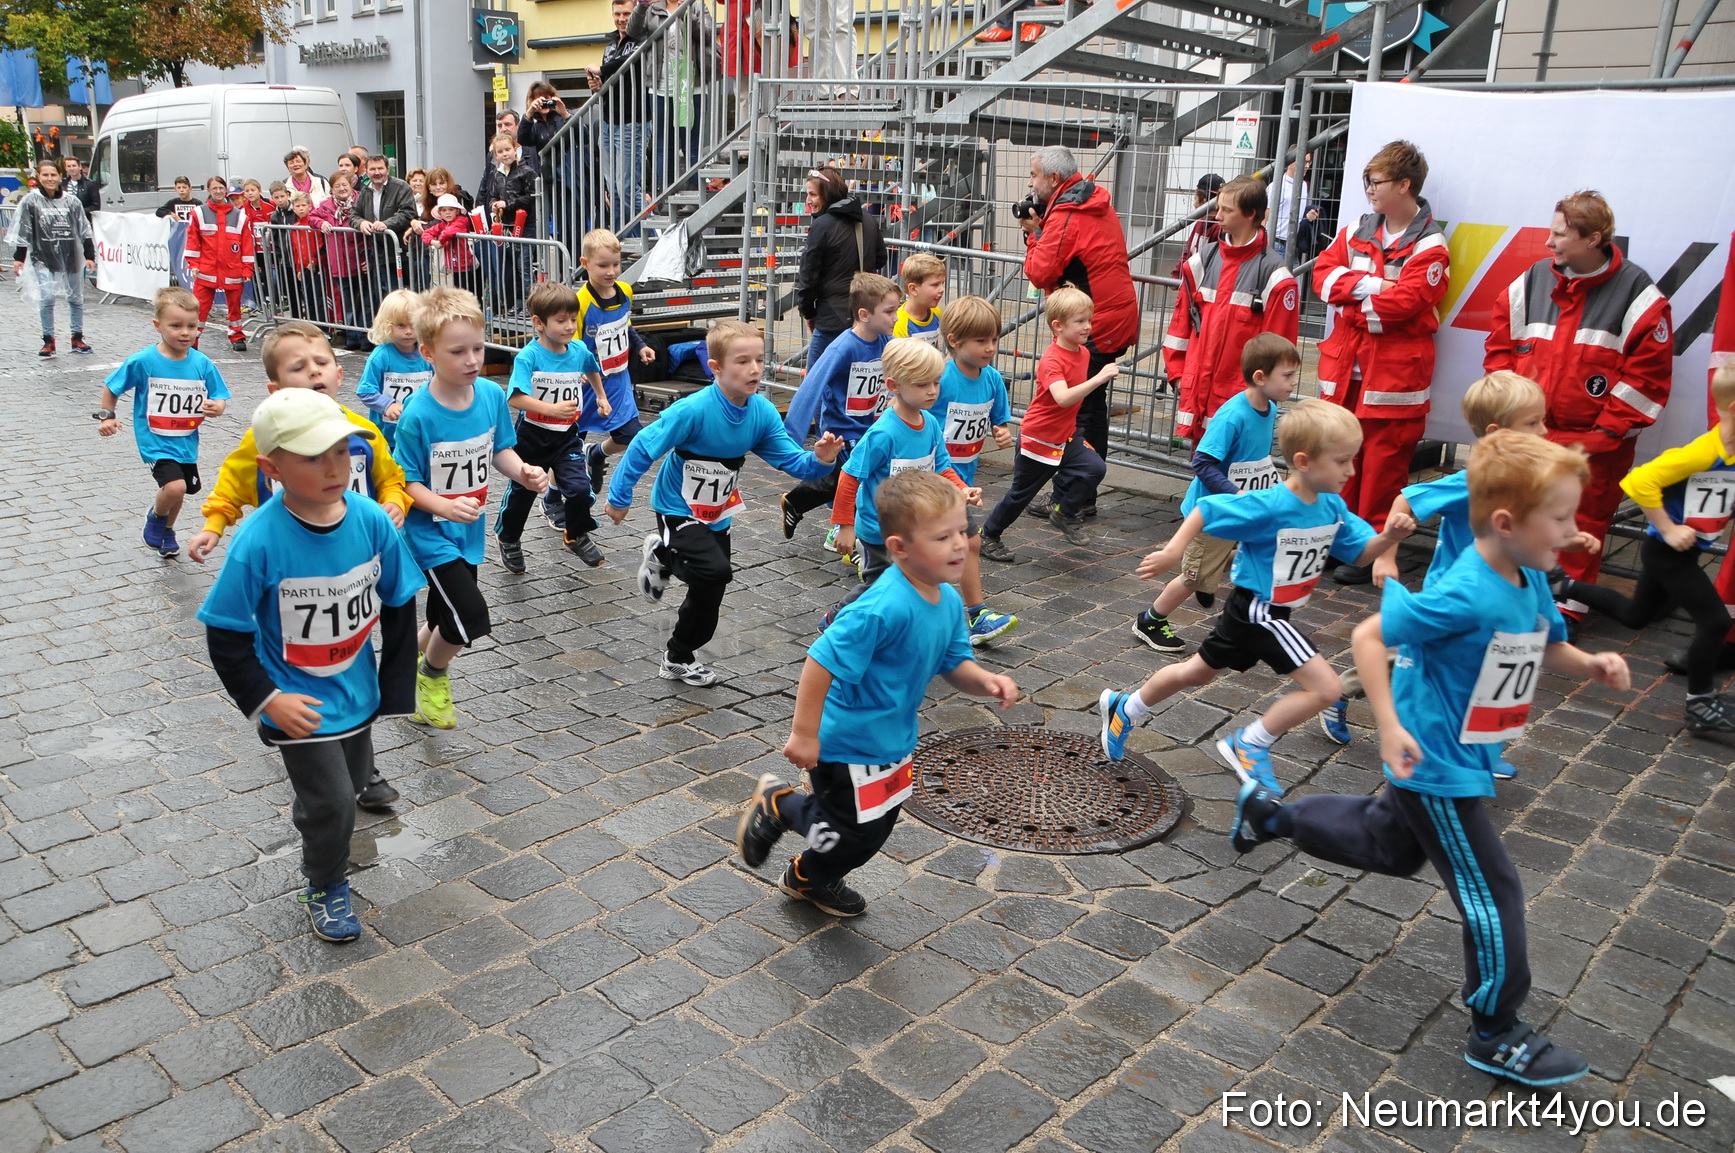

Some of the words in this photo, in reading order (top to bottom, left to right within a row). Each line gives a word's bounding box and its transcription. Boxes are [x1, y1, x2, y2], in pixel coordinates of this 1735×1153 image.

[97, 241, 123, 263] Audi
[127, 244, 142, 267] BKK
[155, 392, 204, 415] 7042
[949, 408, 971, 417] PARTL
[171, 419, 188, 428] Paul
[433, 450, 463, 459] PARTL
[685, 464, 712, 475] PARTL
[1230, 467, 1253, 475] PARTL
[1280, 537, 1309, 546] PARTL
[282, 588, 325, 599] PARTL
[328, 574, 372, 597] Neumarkt
[294, 583, 373, 639] 7190
[329, 639, 358, 662] Paul
